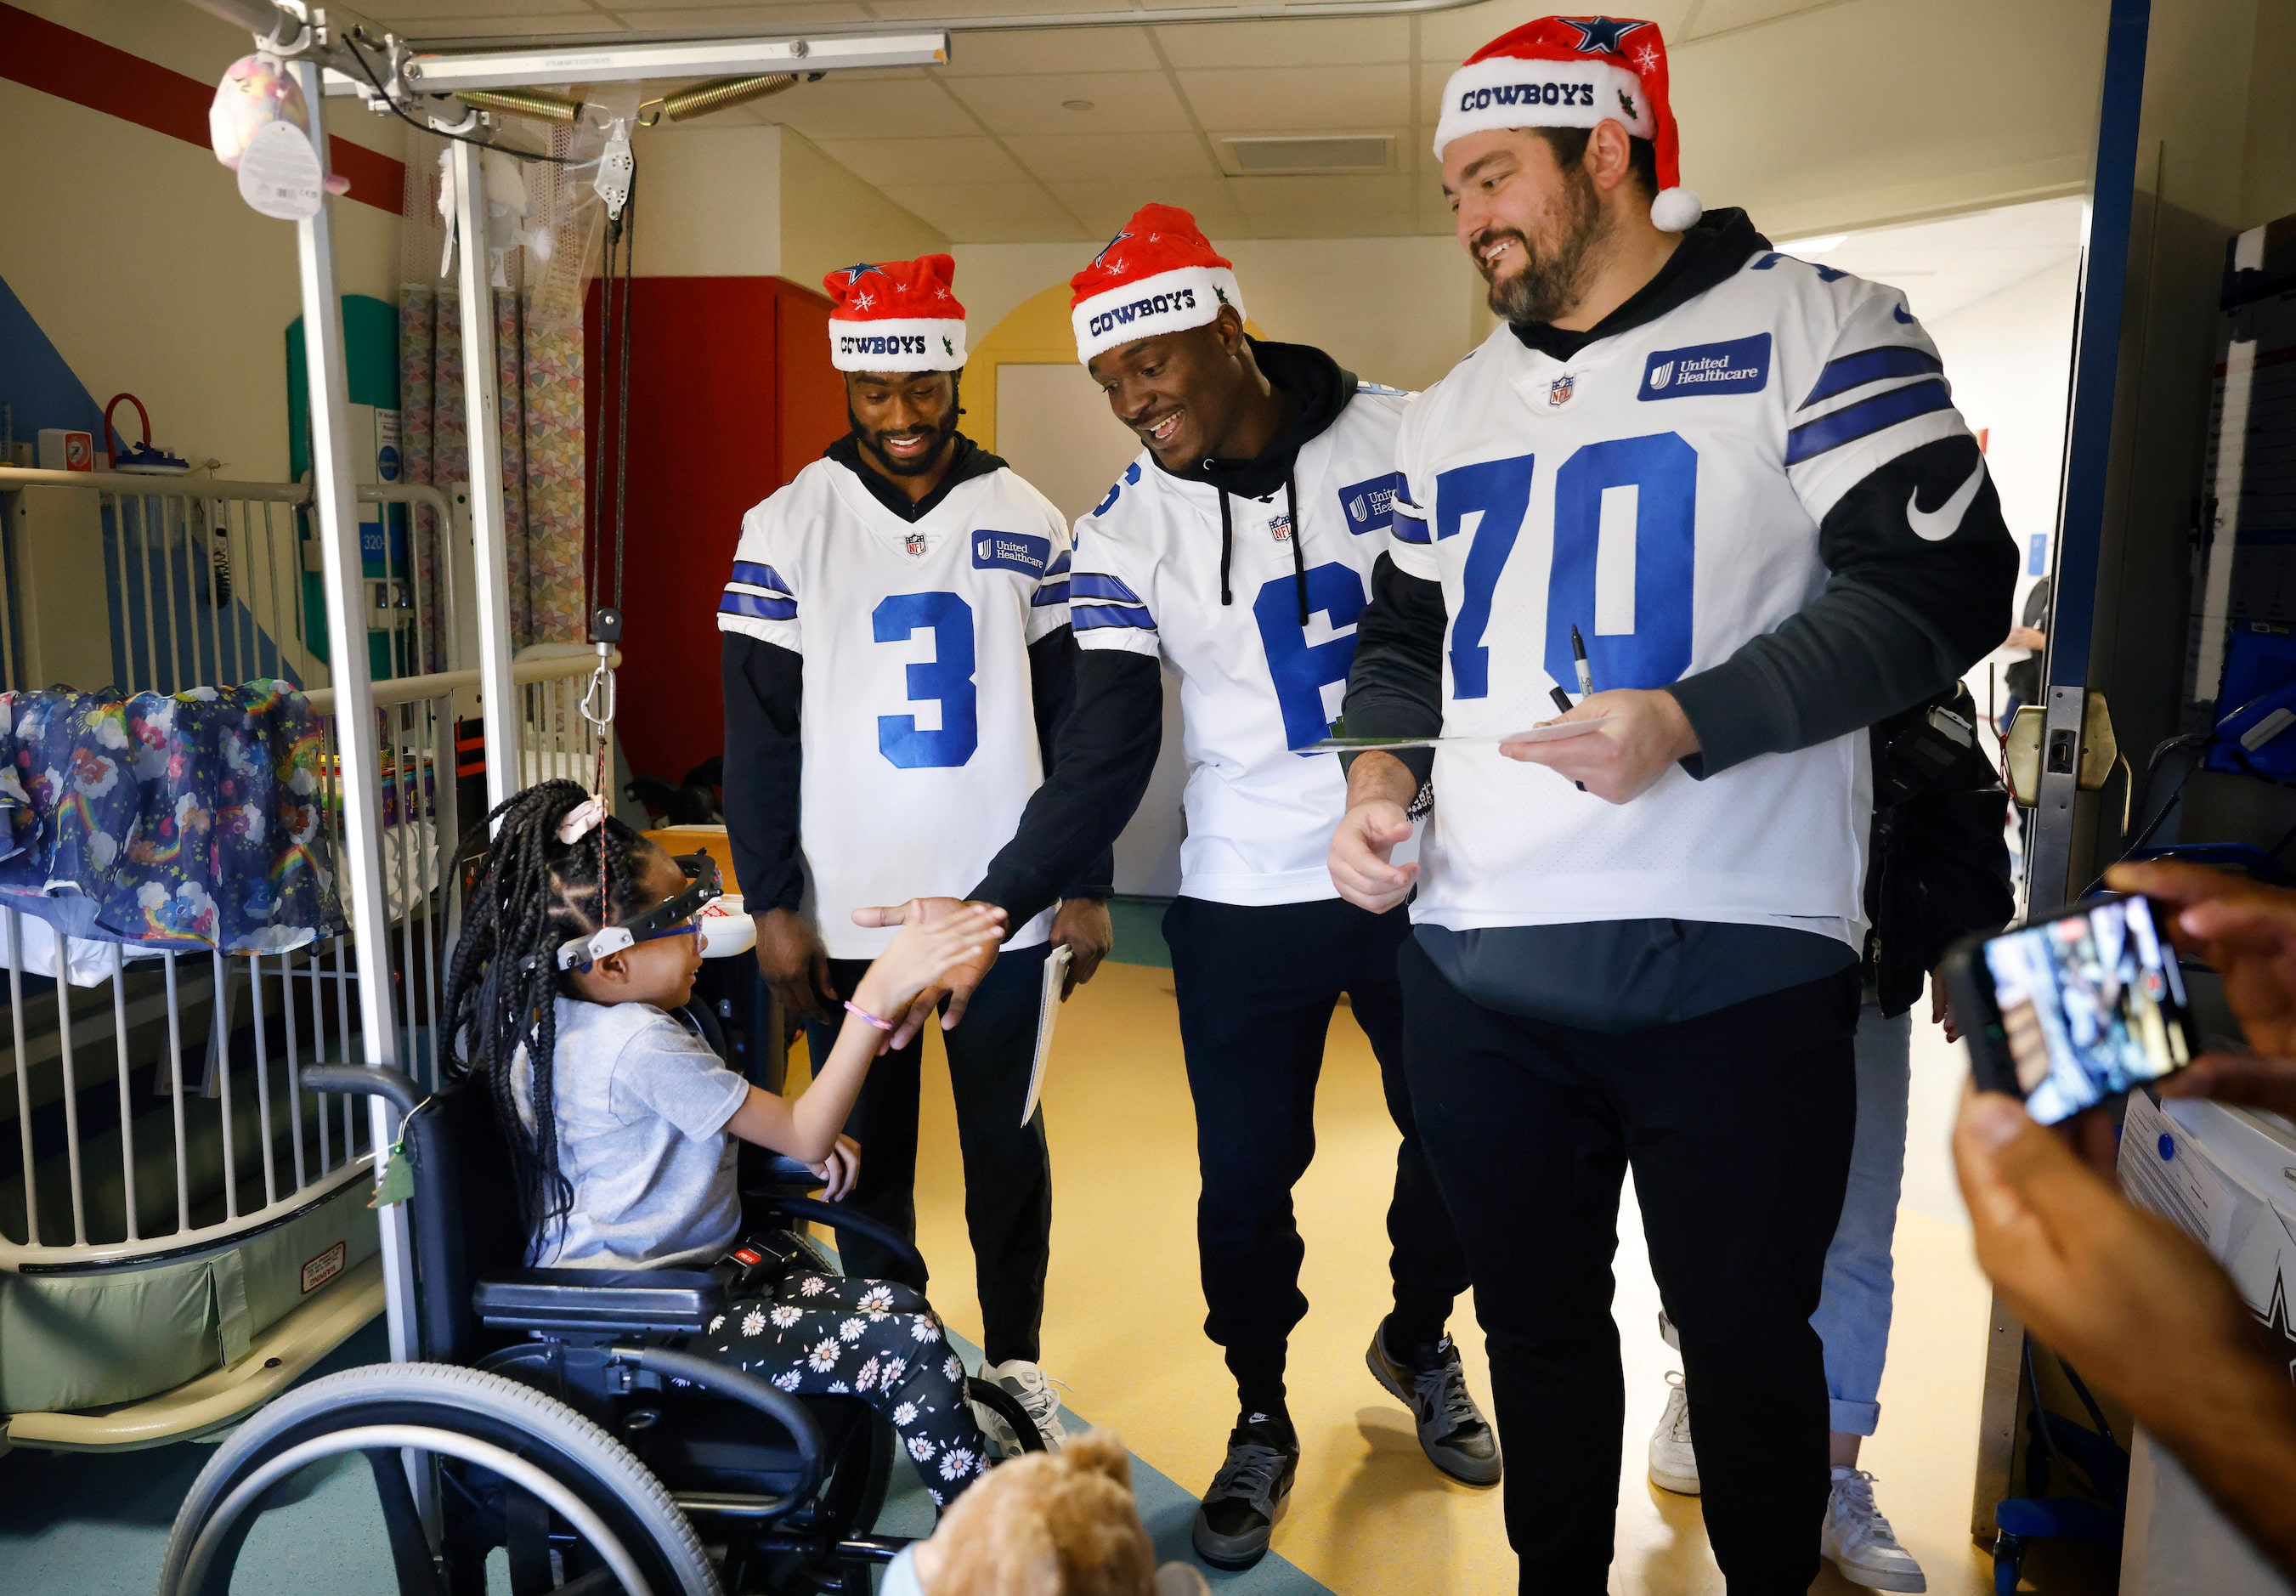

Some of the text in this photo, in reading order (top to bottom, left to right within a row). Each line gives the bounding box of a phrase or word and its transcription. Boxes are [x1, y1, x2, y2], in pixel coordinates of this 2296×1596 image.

[1461, 82, 1594, 112] COWBOYS
[1089, 288, 1196, 337] COWBOYS
[840, 336, 926, 355] COWBOYS
[1679, 355, 1729, 374] United
[1676, 366, 1759, 386] Healthcare
[1552, 388, 1571, 405] NFL
[1274, 524, 1292, 540] NFL
[908, 541, 925, 555] NFL
[996, 540, 1028, 554] United
[996, 549, 1043, 569] Healthcare
[1436, 431, 1698, 699] 70
[1253, 561, 1367, 758] 6
[872, 591, 978, 768] 3
[738, 1252, 755, 1263] PRESS
[309, 1265, 336, 1286] WARNING
